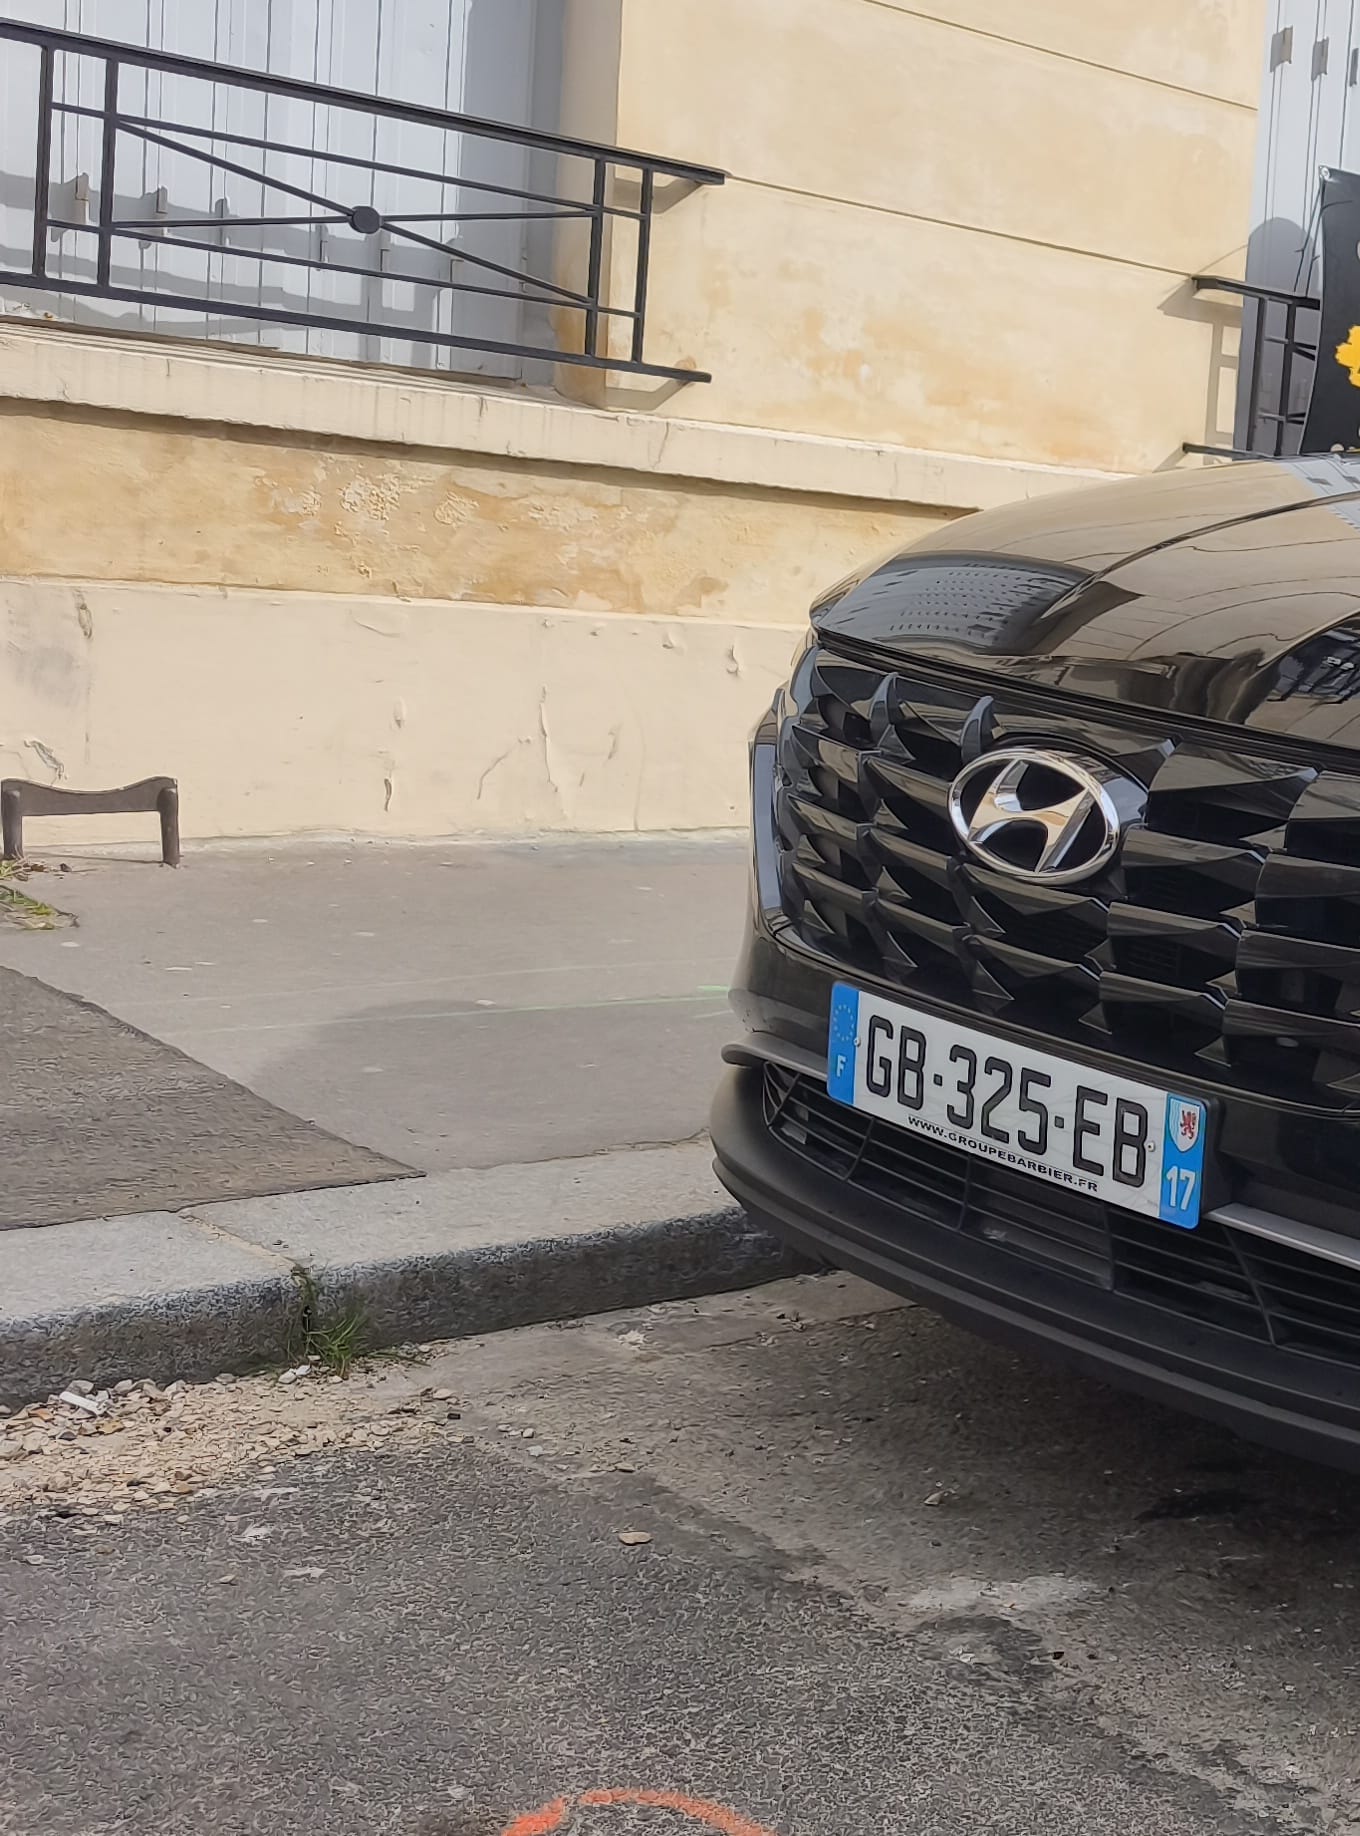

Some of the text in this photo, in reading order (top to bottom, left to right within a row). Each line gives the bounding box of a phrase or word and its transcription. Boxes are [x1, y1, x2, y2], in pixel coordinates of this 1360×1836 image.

[835, 1053, 847, 1078] F
[907, 1115, 1099, 1193] WWW.GROUPEBARBIER.FR
[1165, 1164, 1197, 1212] 17
